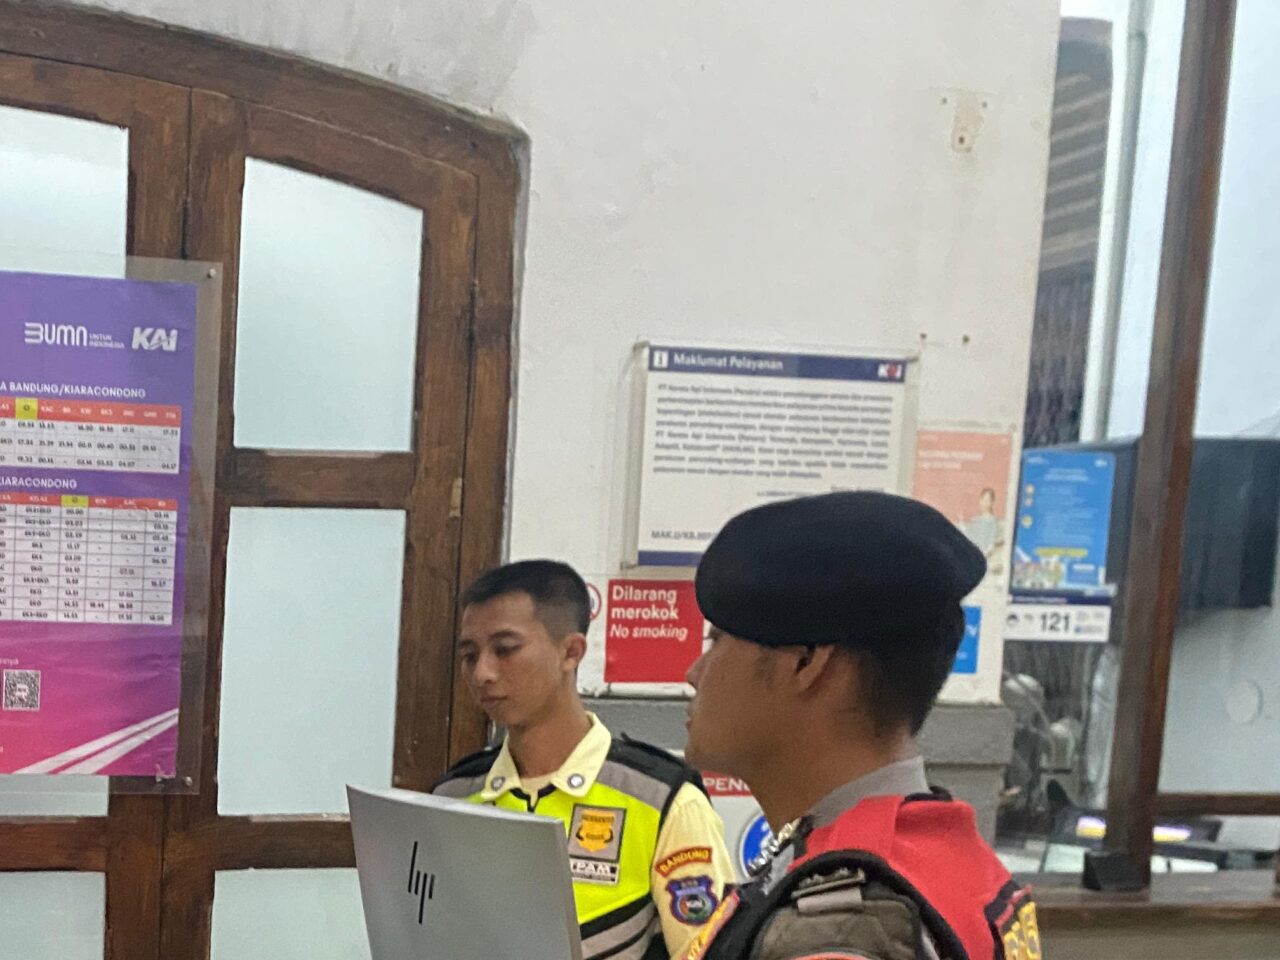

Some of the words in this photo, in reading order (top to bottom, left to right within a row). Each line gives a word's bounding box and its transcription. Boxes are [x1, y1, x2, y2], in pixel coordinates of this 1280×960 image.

[131, 326, 178, 351] KAI
[674, 352, 727, 368] Maklumat
[730, 355, 783, 372] Pelayanan
[612, 585, 677, 605] Dilarang
[611, 604, 679, 621] merokok
[1039, 612, 1070, 632] 121
[610, 623, 630, 639] No
[632, 624, 689, 643] smoking
